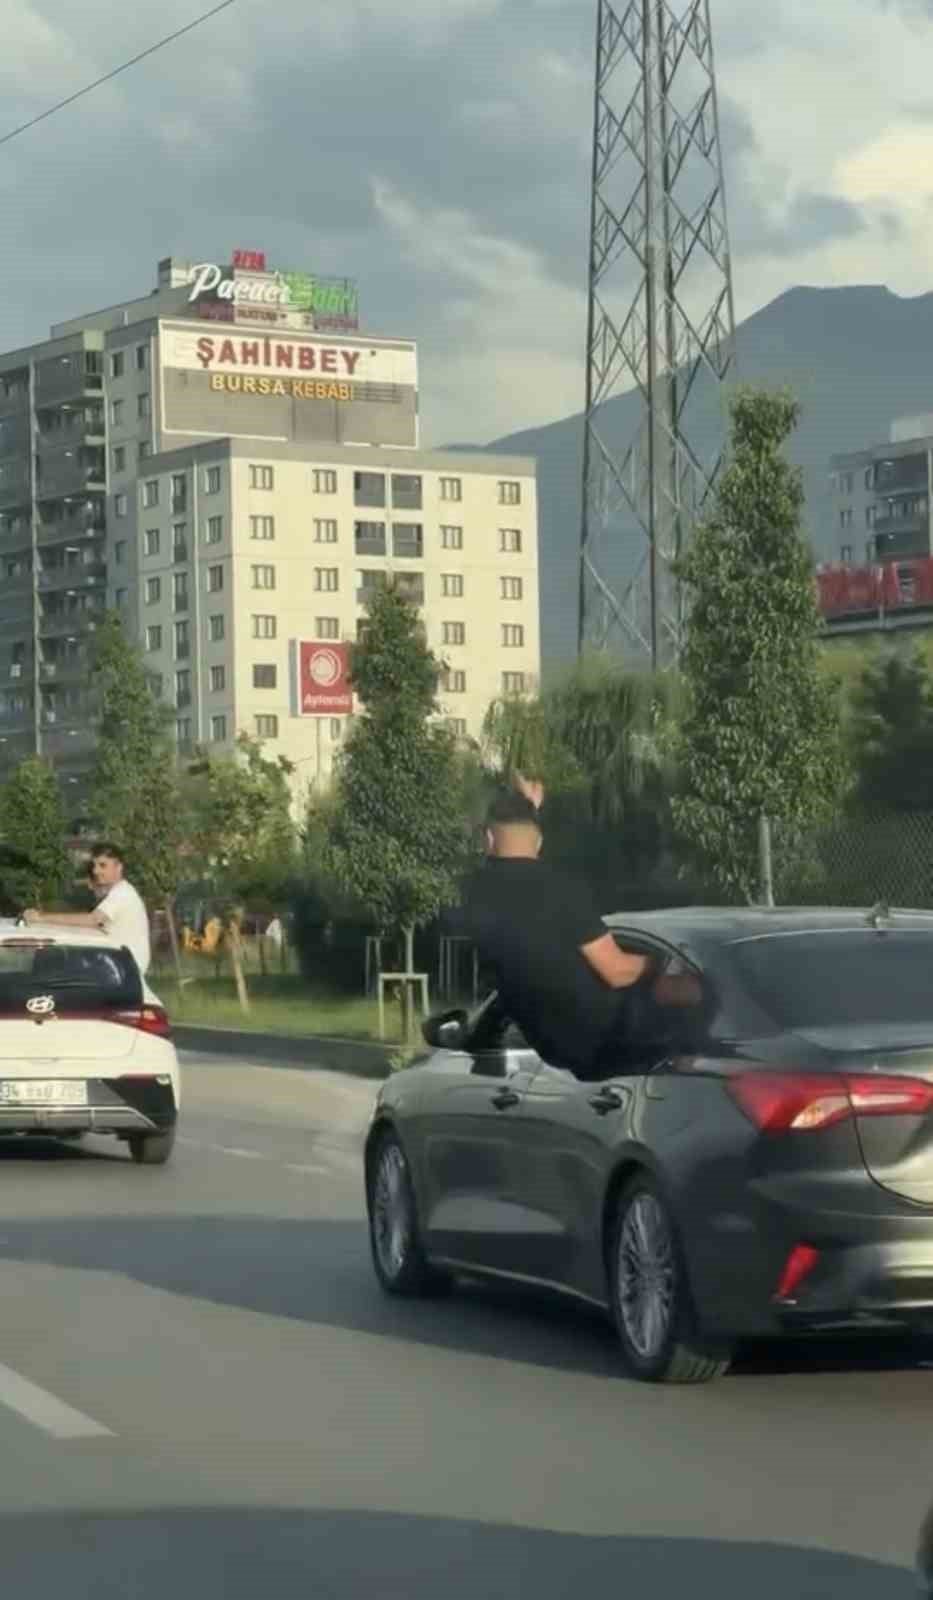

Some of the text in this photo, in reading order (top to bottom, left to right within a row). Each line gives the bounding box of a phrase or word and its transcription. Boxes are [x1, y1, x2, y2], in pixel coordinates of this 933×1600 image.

[197, 336, 360, 376] ŞAHİNBEY
[211, 374, 352, 401] BURSA KEBABI
